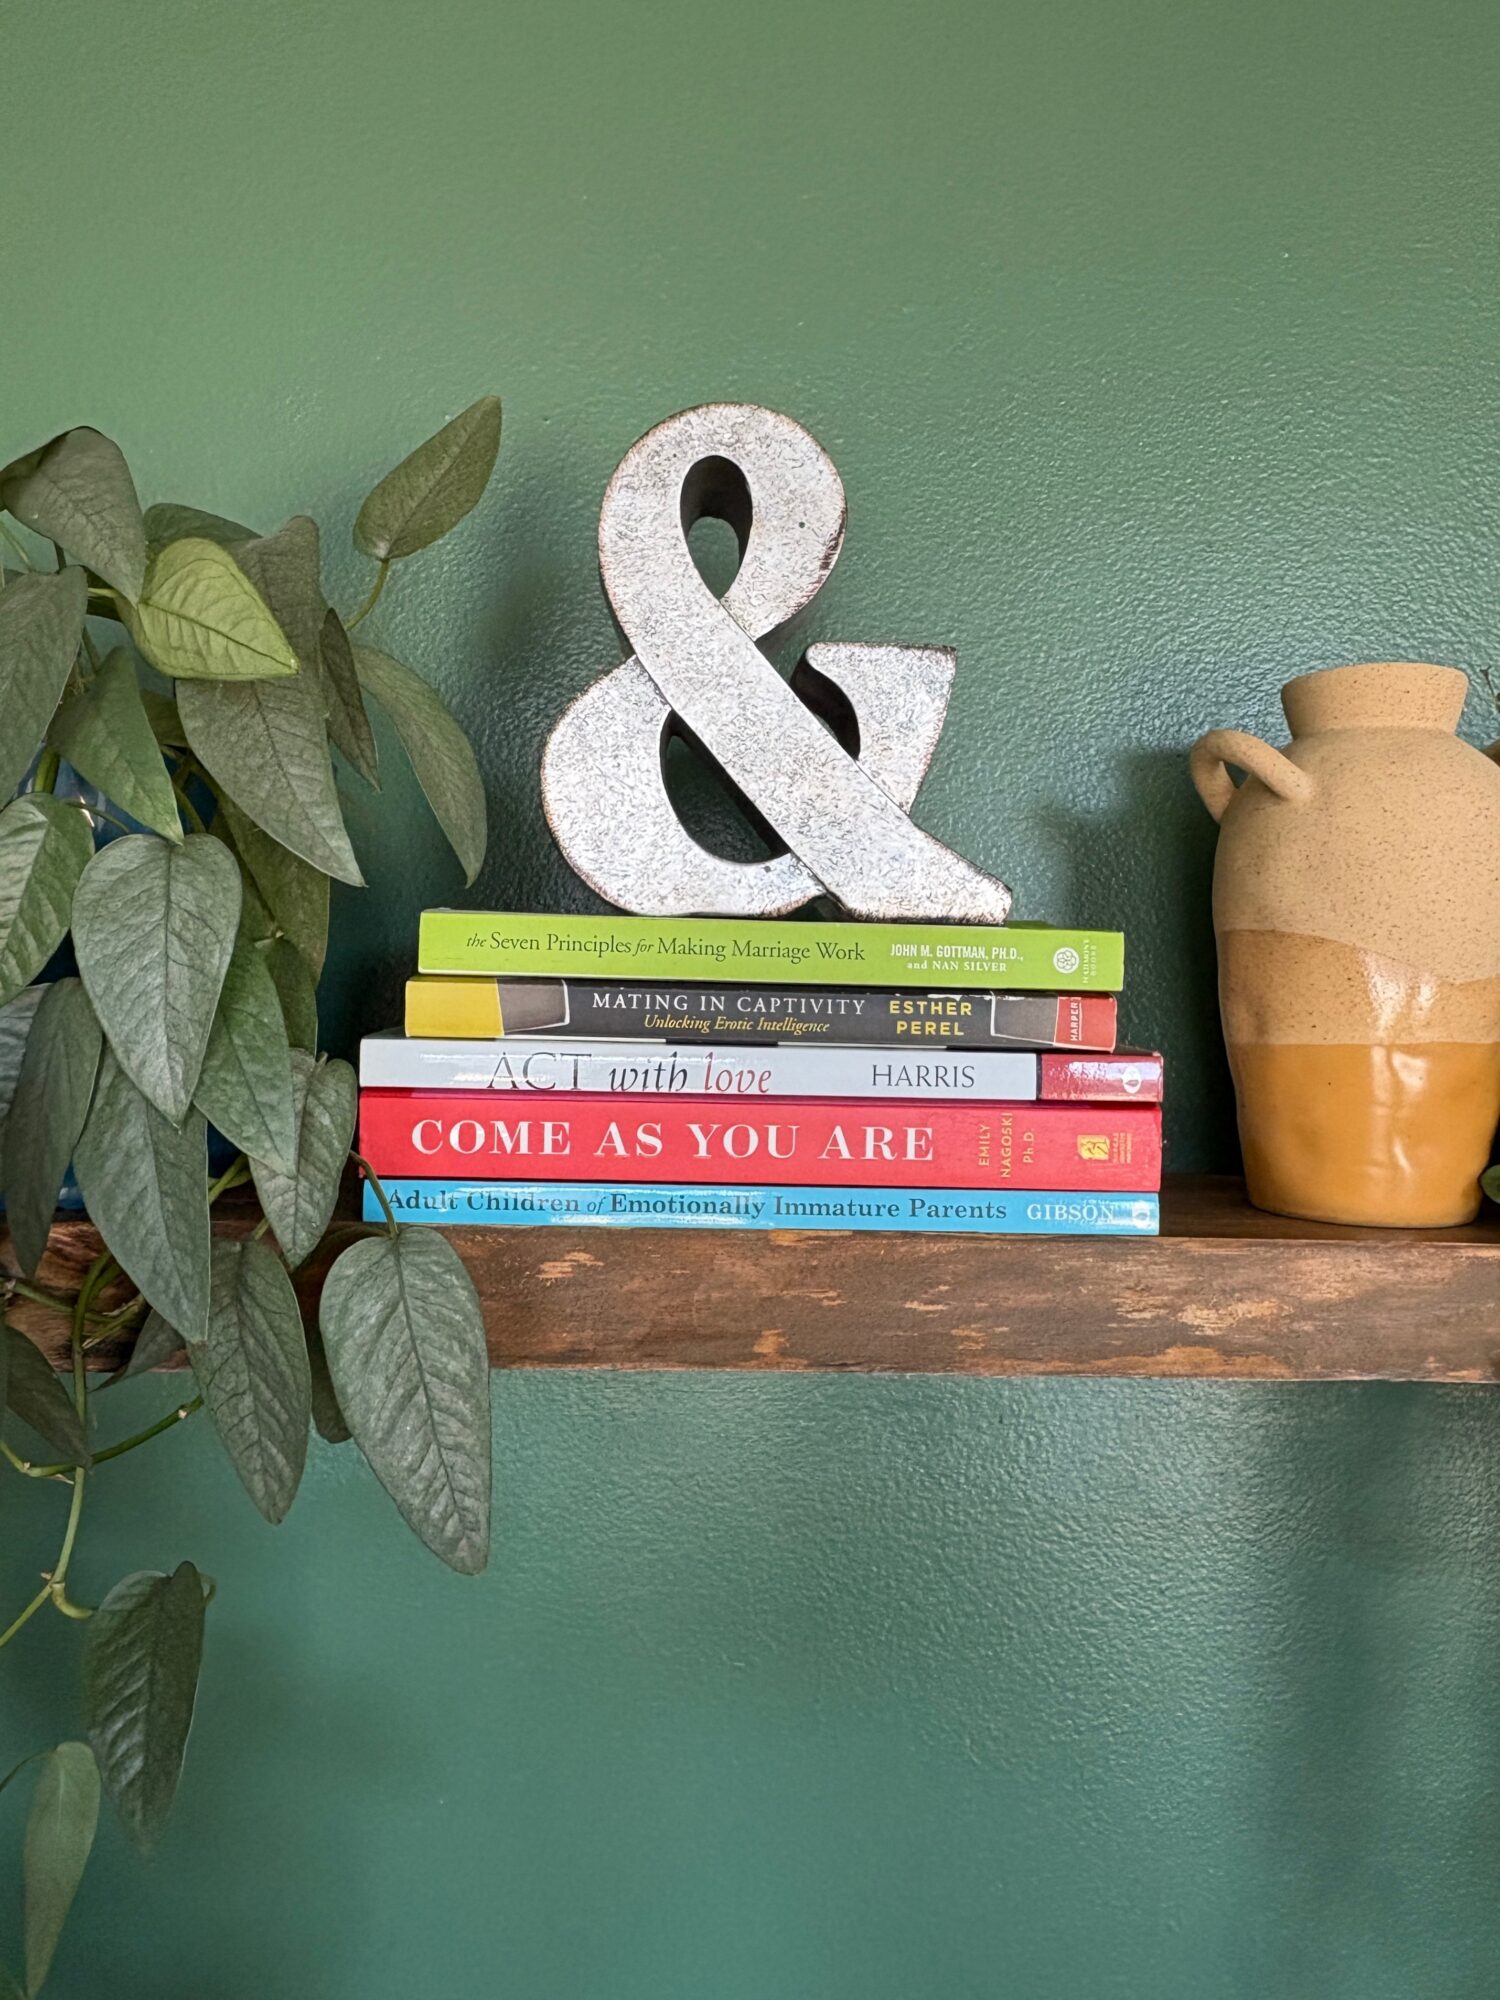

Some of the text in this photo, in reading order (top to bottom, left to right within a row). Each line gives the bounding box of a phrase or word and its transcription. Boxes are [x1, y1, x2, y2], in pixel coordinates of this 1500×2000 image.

[466, 931, 866, 964] the Seven Principles for Making Marriage Work
[890, 943, 917, 957] JOHN
[920, 944, 933, 958] M.
[936, 945, 989, 960] GOTTMAN,
[906, 960, 1008, 972] and NAN SILVER
[592, 992, 866, 1015] MATING IN CAPTIVITY
[889, 1000, 972, 1016] ESTHER
[643, 1014, 831, 1035] Unlocking Erotic Intelligence
[896, 1020, 965, 1036] PEREL
[1070, 1001, 1079, 1041] HARPER
[486, 1051, 772, 1093] ACT with love
[871, 1064, 976, 1089] HARRIS
[411, 1119, 934, 1161] COME AS YOU ARE
[978, 1123, 991, 1166] EMILY
[1000, 1112, 1014, 1178] NAGOSKI
[388, 1188, 1007, 1219] Adult Children of Emotionally Immature Parents
[1026, 1203, 1114, 1221] GIBSON
